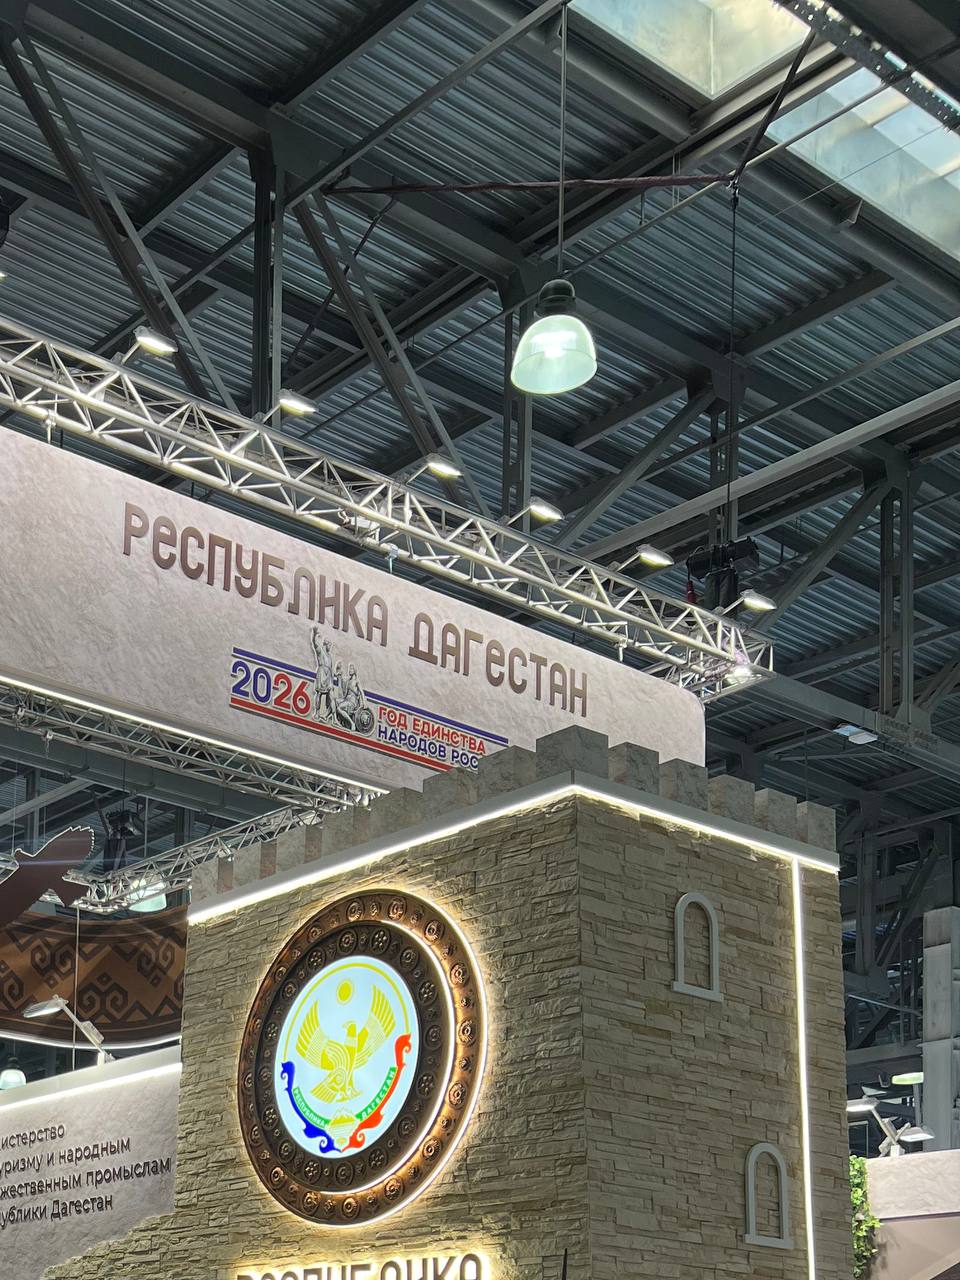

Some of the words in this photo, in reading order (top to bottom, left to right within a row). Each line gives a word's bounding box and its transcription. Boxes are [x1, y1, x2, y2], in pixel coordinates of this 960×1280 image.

[230, 659, 312, 716] 2026
[378, 706, 408, 729] ГОД
[412, 716, 486, 755] ЕДИНСТВА
[378, 725, 447, 759] НАРОДОВ
[361, 1070, 396, 1120] ДАГЕСТАН
[46, 1150, 56, 1167] и
[58, 1137, 131, 1167] народным
[86, 1157, 172, 1188] промыслам
[50, 1194, 114, 1222] Дагестан
